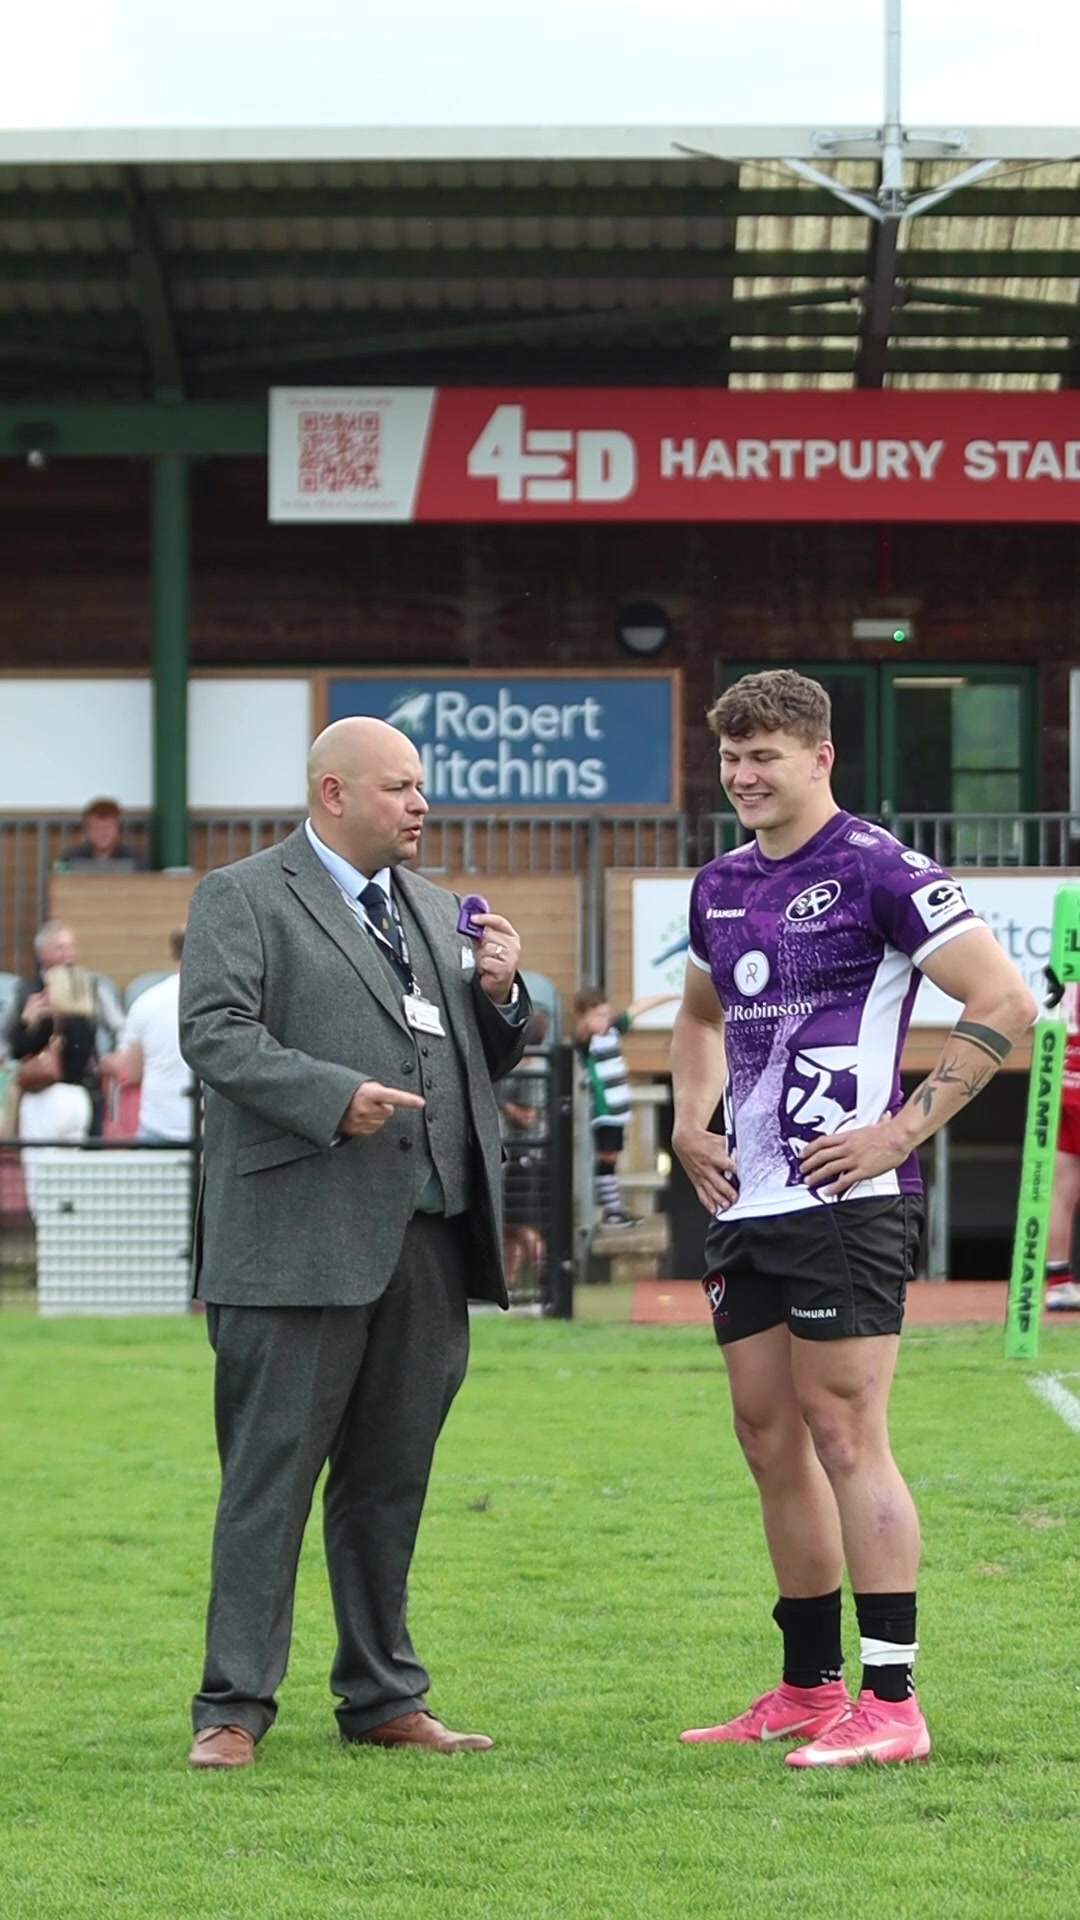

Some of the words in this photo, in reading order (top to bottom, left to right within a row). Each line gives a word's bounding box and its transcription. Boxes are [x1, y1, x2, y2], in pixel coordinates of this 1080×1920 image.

[660, 438, 943, 481] HARTPURY
[434, 688, 604, 740] Robert
[733, 1001, 813, 1021] Robinson
[1035, 1030, 1056, 1148] CHAMP
[1017, 1216, 1040, 1333] CHAMP
[794, 1307, 837, 1319] SAMURAI
